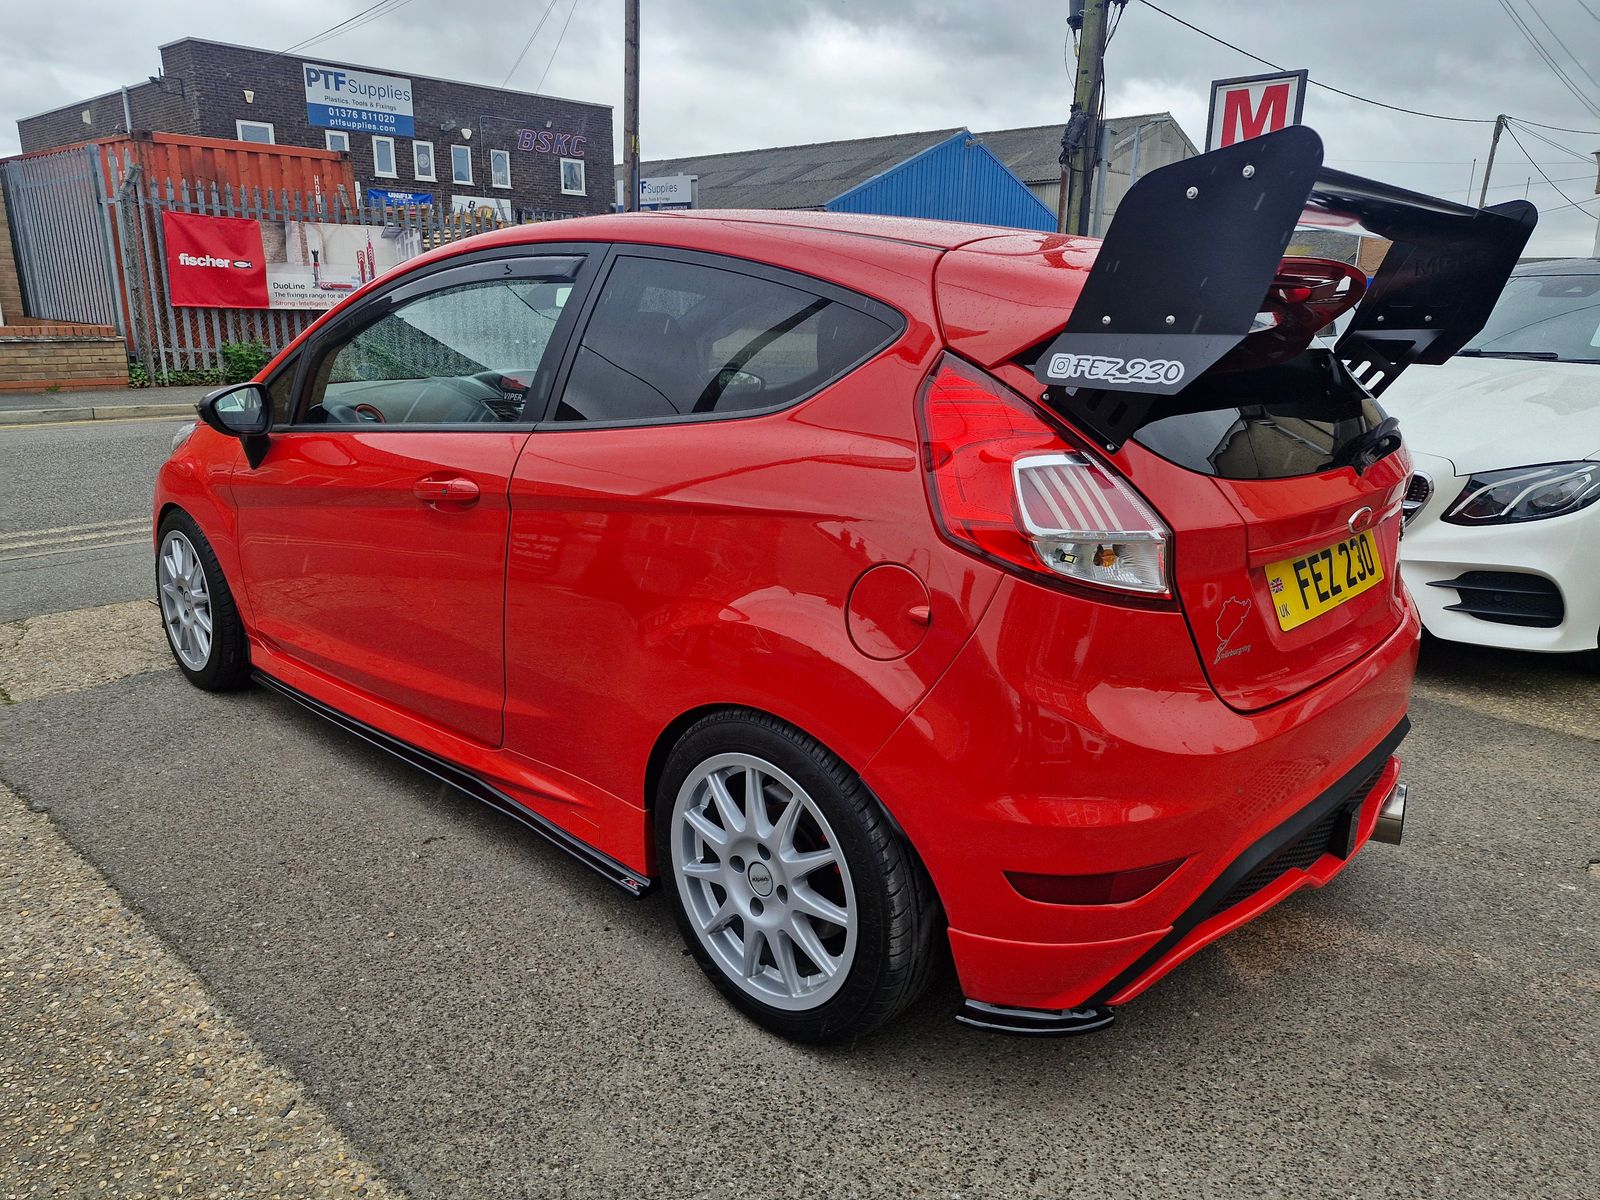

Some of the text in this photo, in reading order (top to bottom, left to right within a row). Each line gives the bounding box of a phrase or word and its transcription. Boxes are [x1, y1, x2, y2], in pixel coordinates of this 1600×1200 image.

[305, 67, 411, 102] PTF Supplies
[324, 96, 351, 105] Plastics,
[352, 99, 368, 107] Tools
[376, 102, 397, 111] Fixings
[328, 107, 395, 124] 01376 811020
[1220, 83, 1290, 148] M
[330, 118, 396, 132] ptfsupplies.com
[517, 128, 587, 157] BSKC
[647, 183, 678, 195] Supplies
[178, 252, 230, 268] fischer
[272, 282, 306, 290] DuoLine
[287, 291, 308, 300] fixings
[503, 392, 523, 401] VIPER
[1292, 533, 1375, 610] FEZ 230
[1279, 603, 1291, 618] UK
